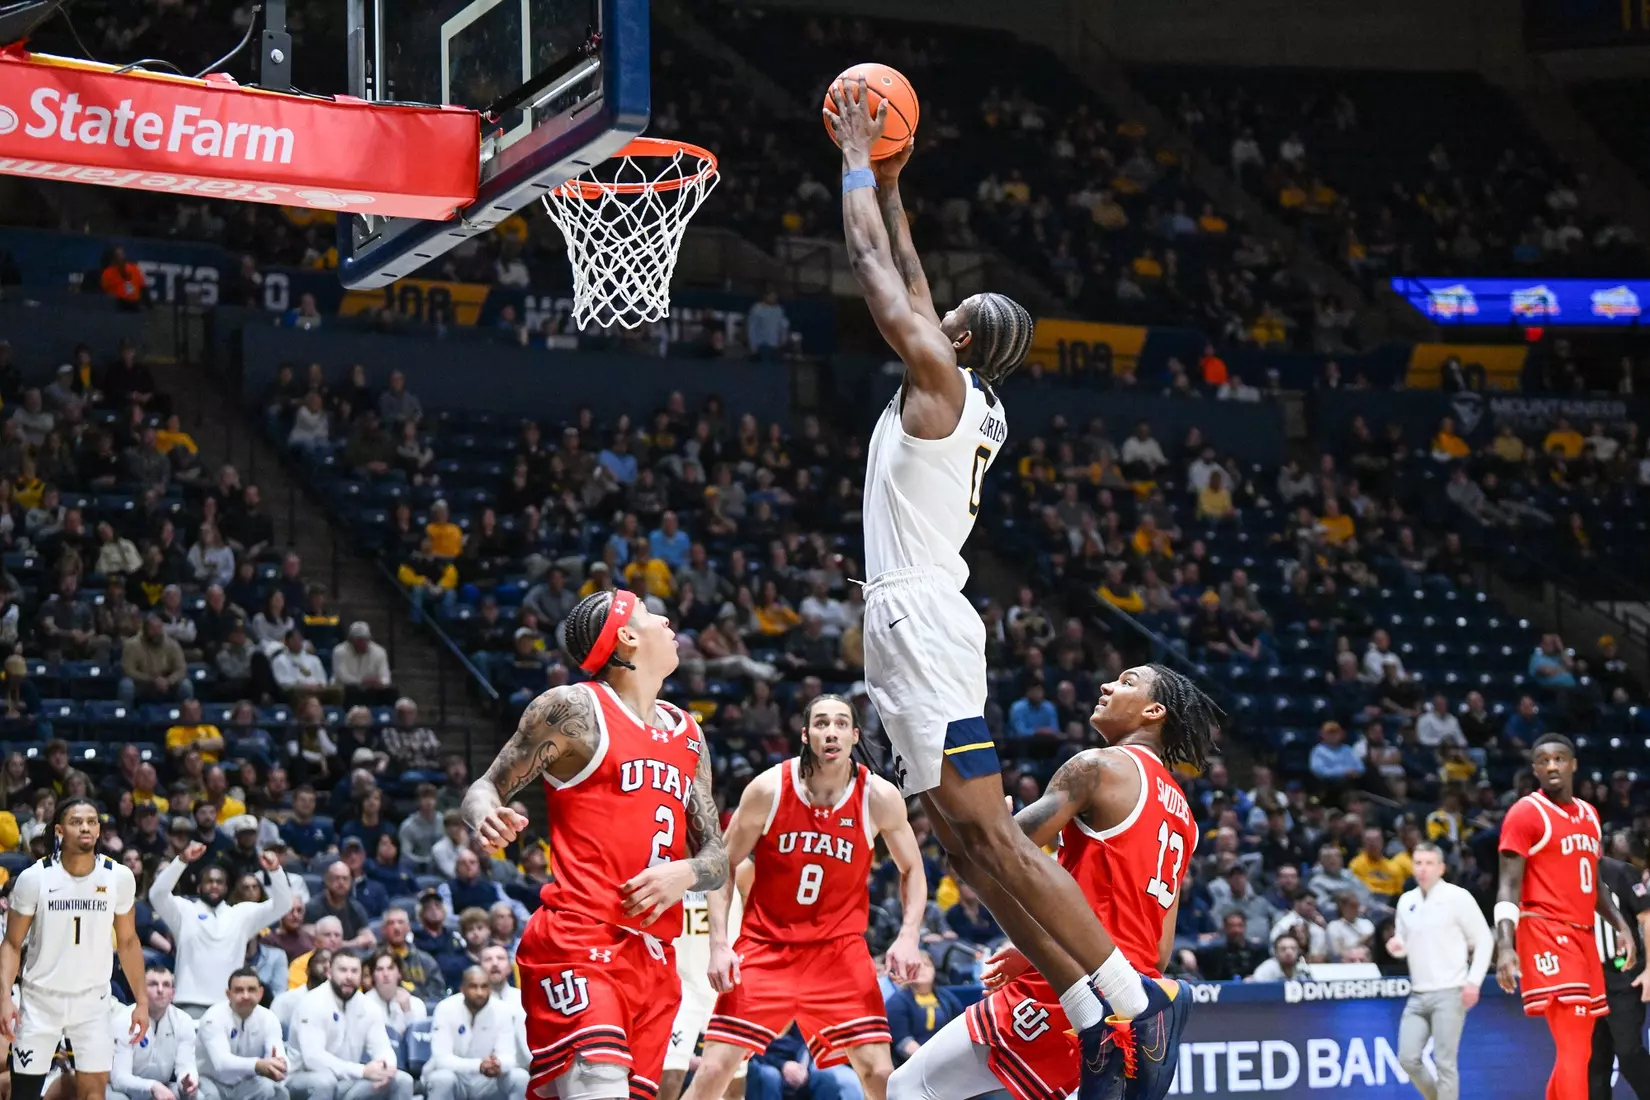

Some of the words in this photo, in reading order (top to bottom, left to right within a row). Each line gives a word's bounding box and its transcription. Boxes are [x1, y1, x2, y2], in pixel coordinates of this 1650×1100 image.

[967, 442, 992, 518] 0
[647, 804, 675, 869] 2
[778, 830, 854, 865] UTAH
[796, 862, 824, 906] 8
[1146, 818, 1184, 910] 13
[1579, 856, 1594, 895] 0
[48, 899, 107, 912] MOUNTAINEERS
[73, 916, 82, 946] 1
[1303, 978, 1411, 1001] DIVERSIFIED
[1168, 1039, 1300, 1094] ITED
